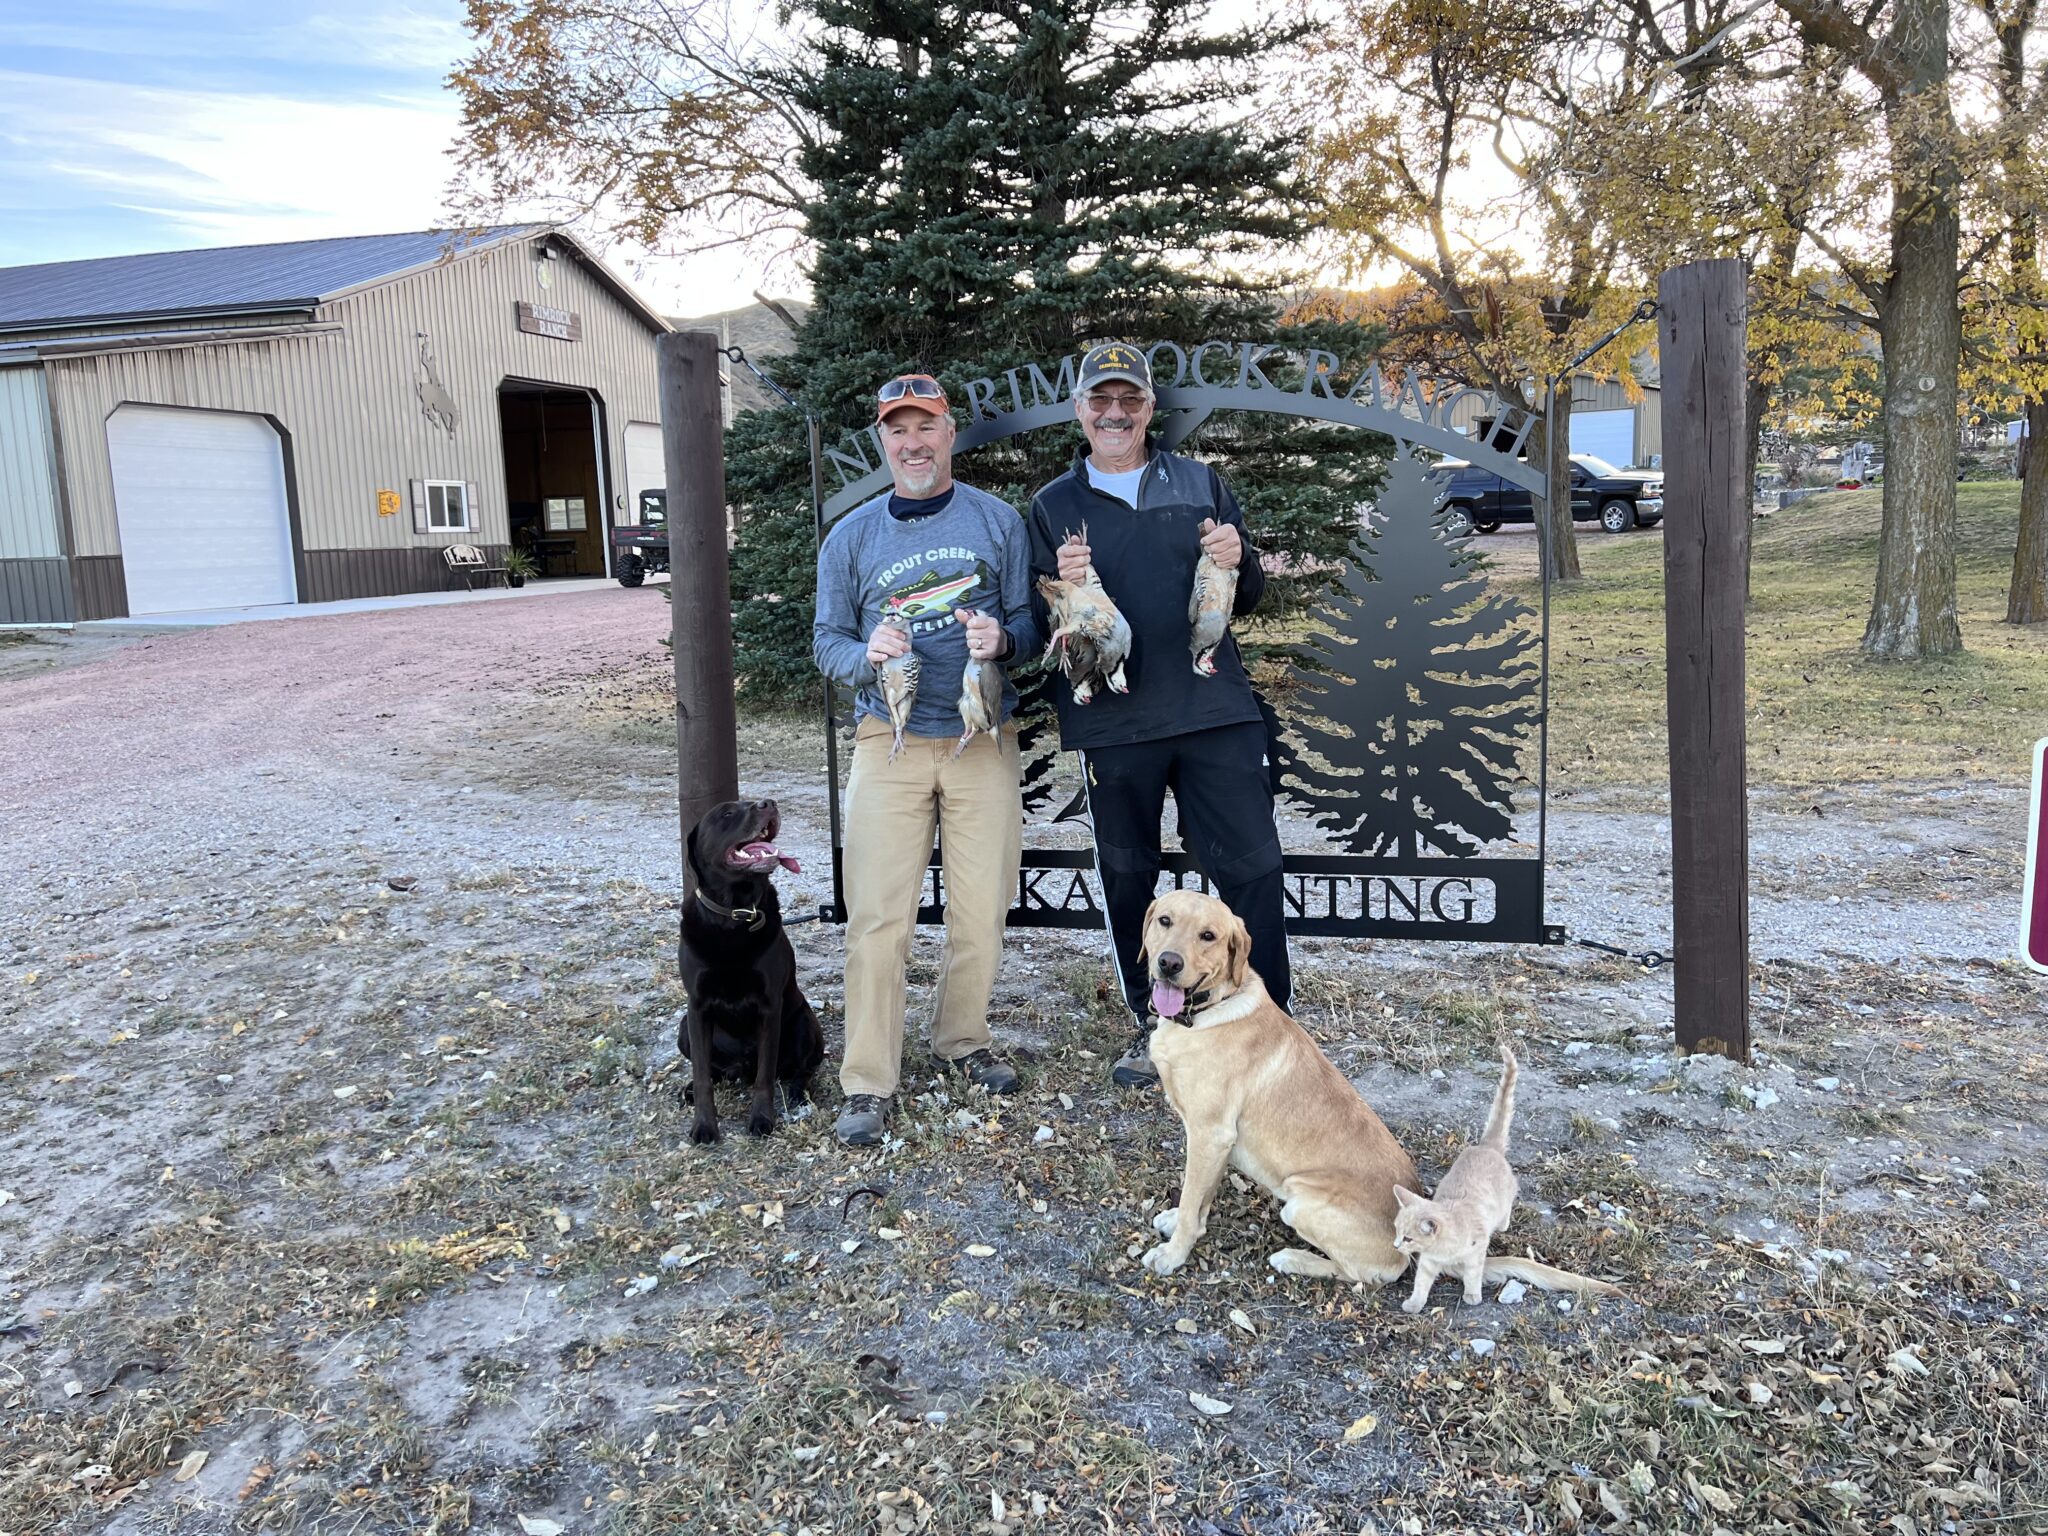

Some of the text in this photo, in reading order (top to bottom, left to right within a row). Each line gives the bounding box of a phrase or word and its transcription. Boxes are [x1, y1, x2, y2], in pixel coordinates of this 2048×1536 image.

[532, 303, 572, 326] RIMROCK
[539, 320, 568, 338] RANCH
[963, 340, 1280, 424] RIMOCK
[1299, 348, 1543, 459] RANCH
[877, 547, 976, 588] TROUT CREEK
[912, 614, 956, 633] FLIE
